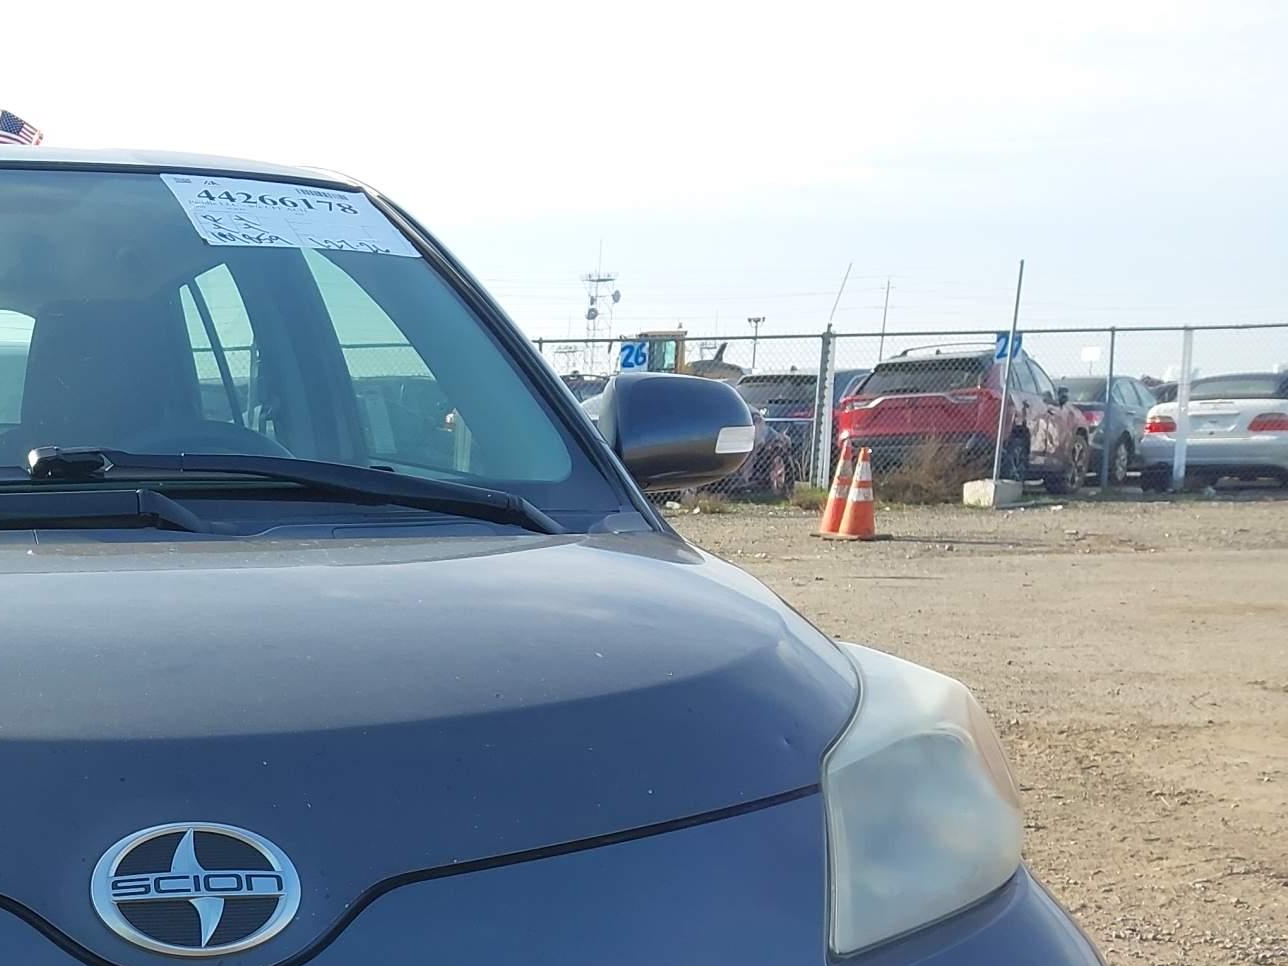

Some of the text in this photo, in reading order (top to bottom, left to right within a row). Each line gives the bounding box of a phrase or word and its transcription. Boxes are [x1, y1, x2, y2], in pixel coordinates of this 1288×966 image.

[197, 189, 360, 215] 44266178
[620, 342, 647, 368] 26
[111, 873, 283, 897] SCION
